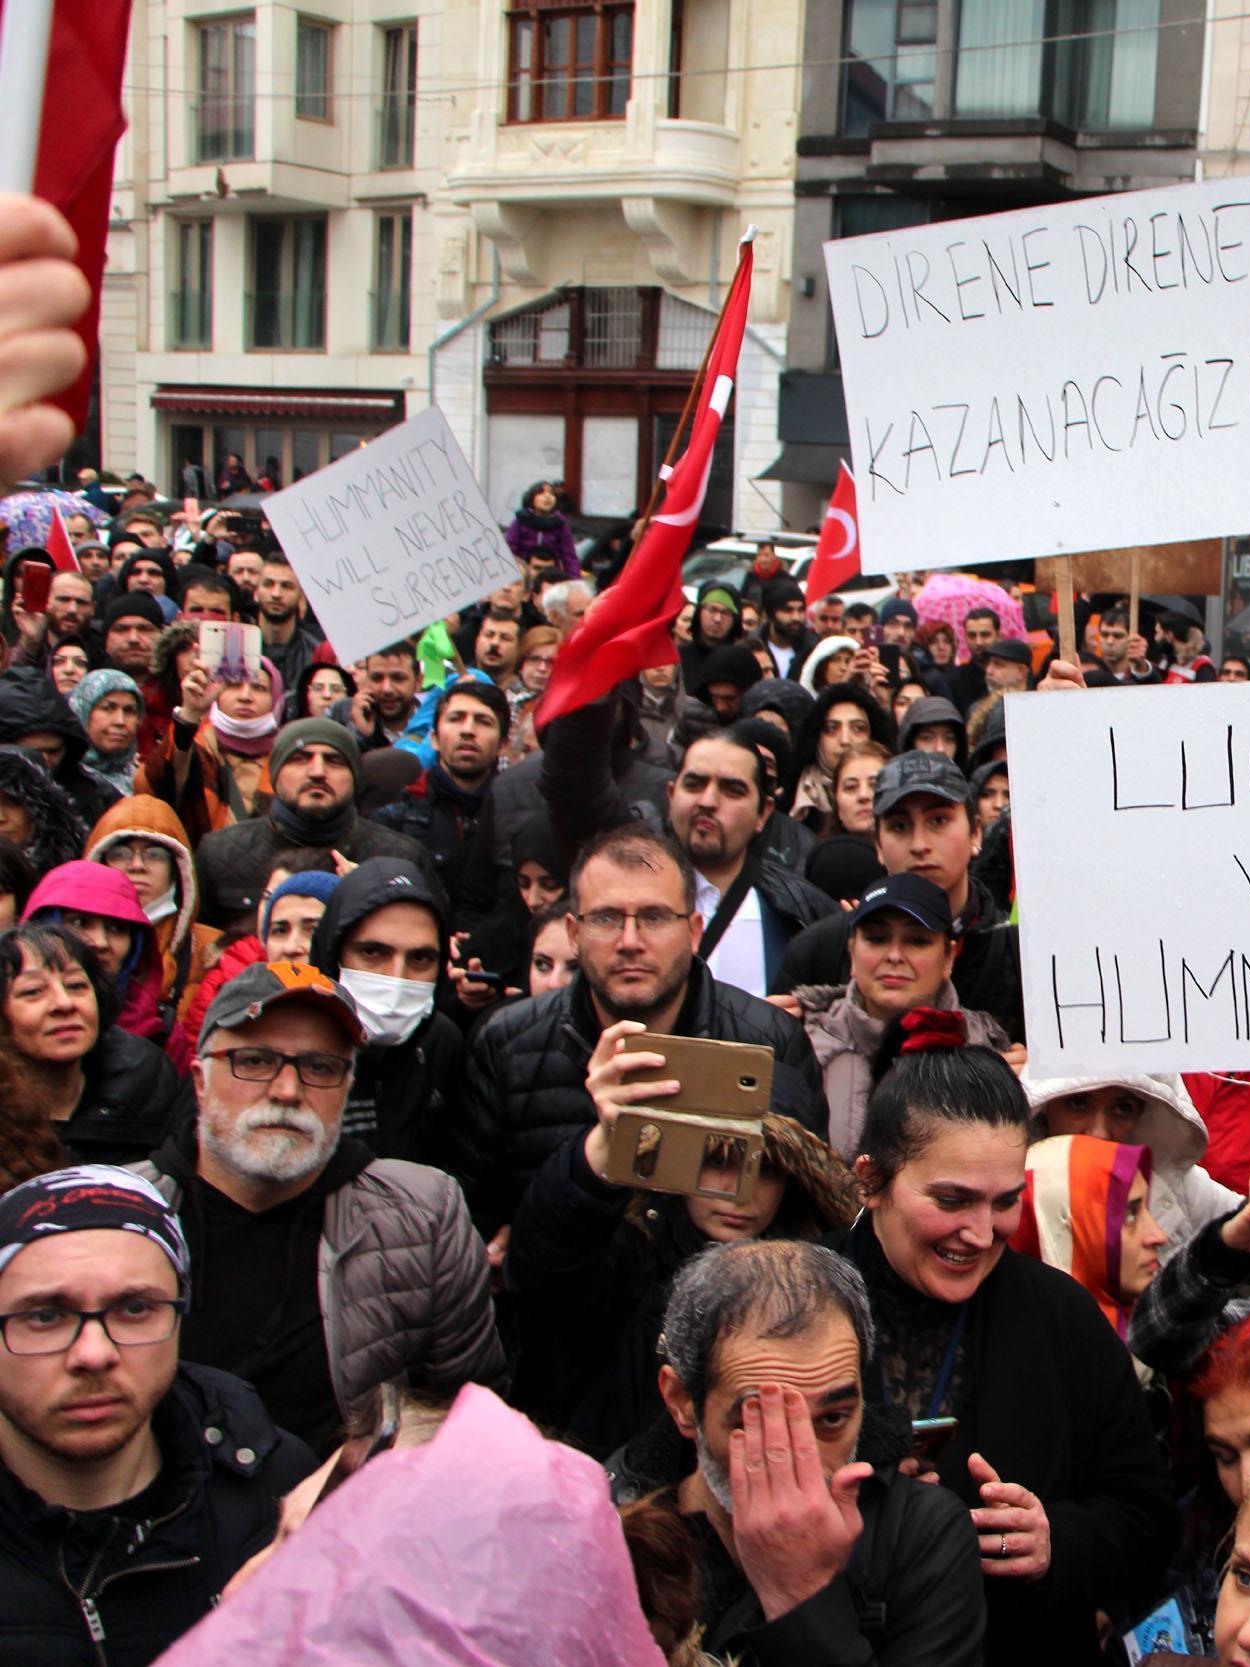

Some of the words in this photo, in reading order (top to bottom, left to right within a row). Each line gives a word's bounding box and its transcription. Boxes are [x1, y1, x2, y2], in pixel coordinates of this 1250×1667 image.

[290, 430, 458, 550] HUMMANITY
[310, 546, 389, 595] WILL
[393, 490, 486, 557] NEVER
[370, 527, 518, 627] SURRENDER
